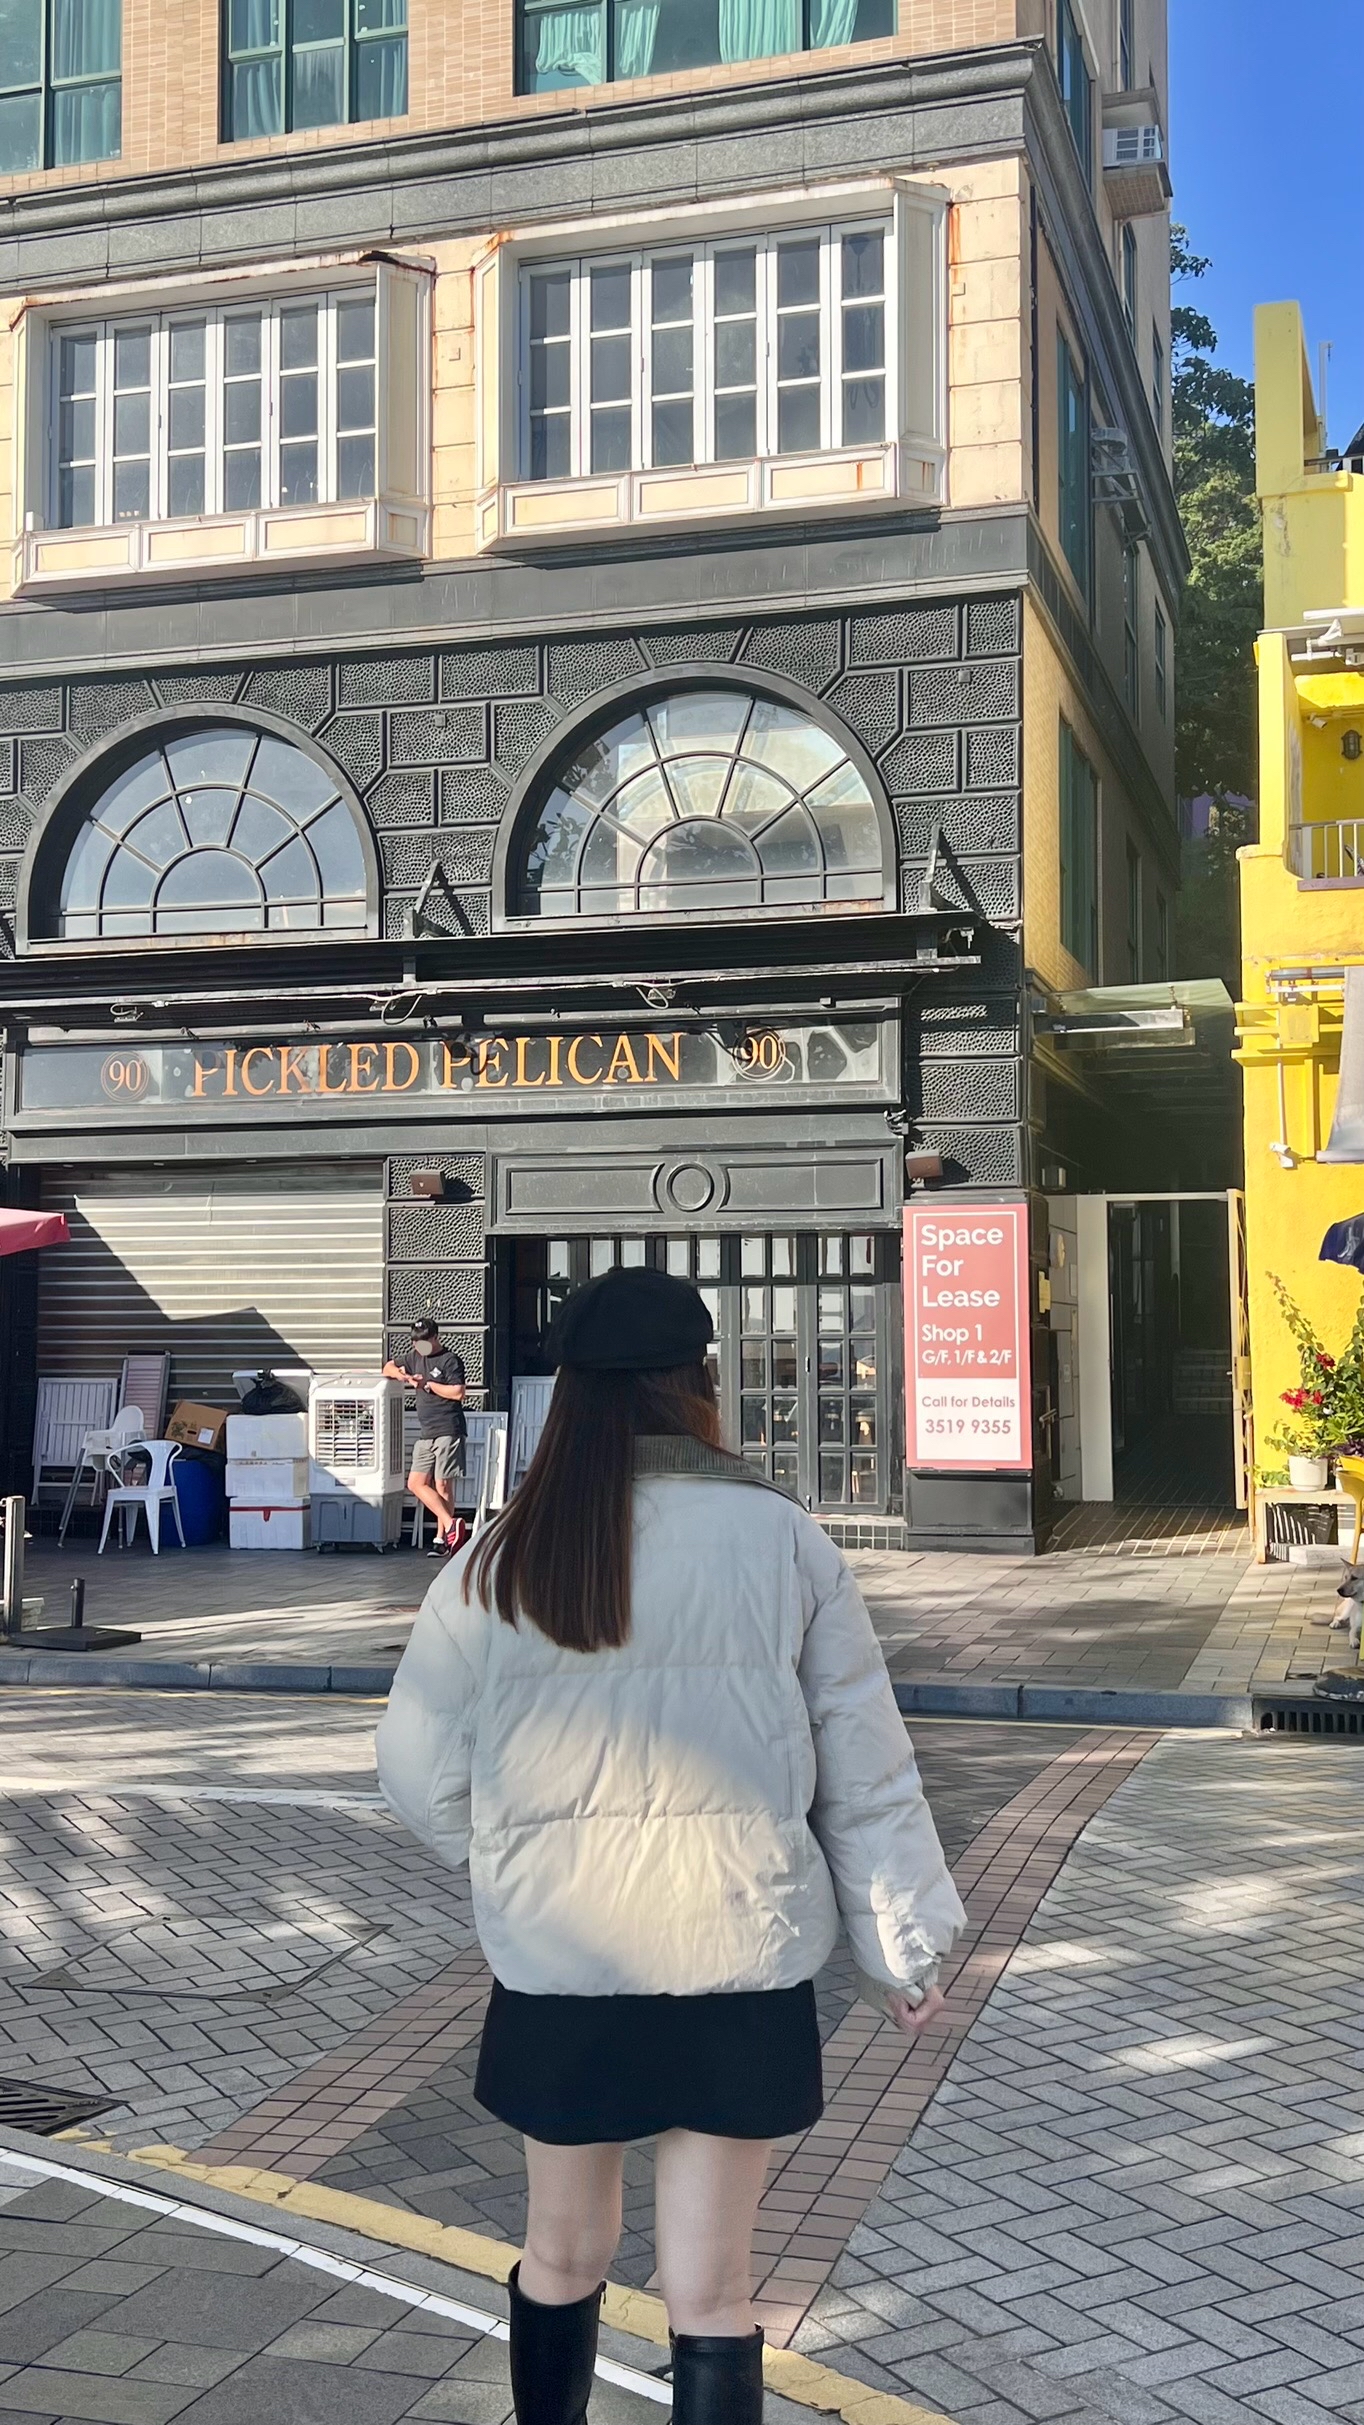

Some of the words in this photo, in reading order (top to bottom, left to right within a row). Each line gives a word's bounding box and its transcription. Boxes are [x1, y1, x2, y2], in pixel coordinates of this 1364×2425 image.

[109, 1060, 142, 1091] 90
[191, 1042, 420, 1097] PICKLED
[440, 1032, 685, 1089] PELICAN
[740, 1035, 778, 1071] 90
[920, 1224, 1004, 1251] Space
[921, 1255, 964, 1277] For
[922, 1286, 1001, 1308] Lease
[921, 1324, 970, 1345] Shop
[975, 1324, 983, 1341] 1
[921, 1349, 952, 1366] G/F,
[954, 1349, 975, 1366] 1/F
[976, 1349, 988, 1364] &
[989, 1349, 1012, 1366] 2/F
[921, 1396, 947, 1408] Call
[951, 1396, 968, 1408] for
[972, 1396, 1016, 1408] Details
[925, 1419, 965, 1434] 3519
[971, 1419, 1012, 1434] 9355
